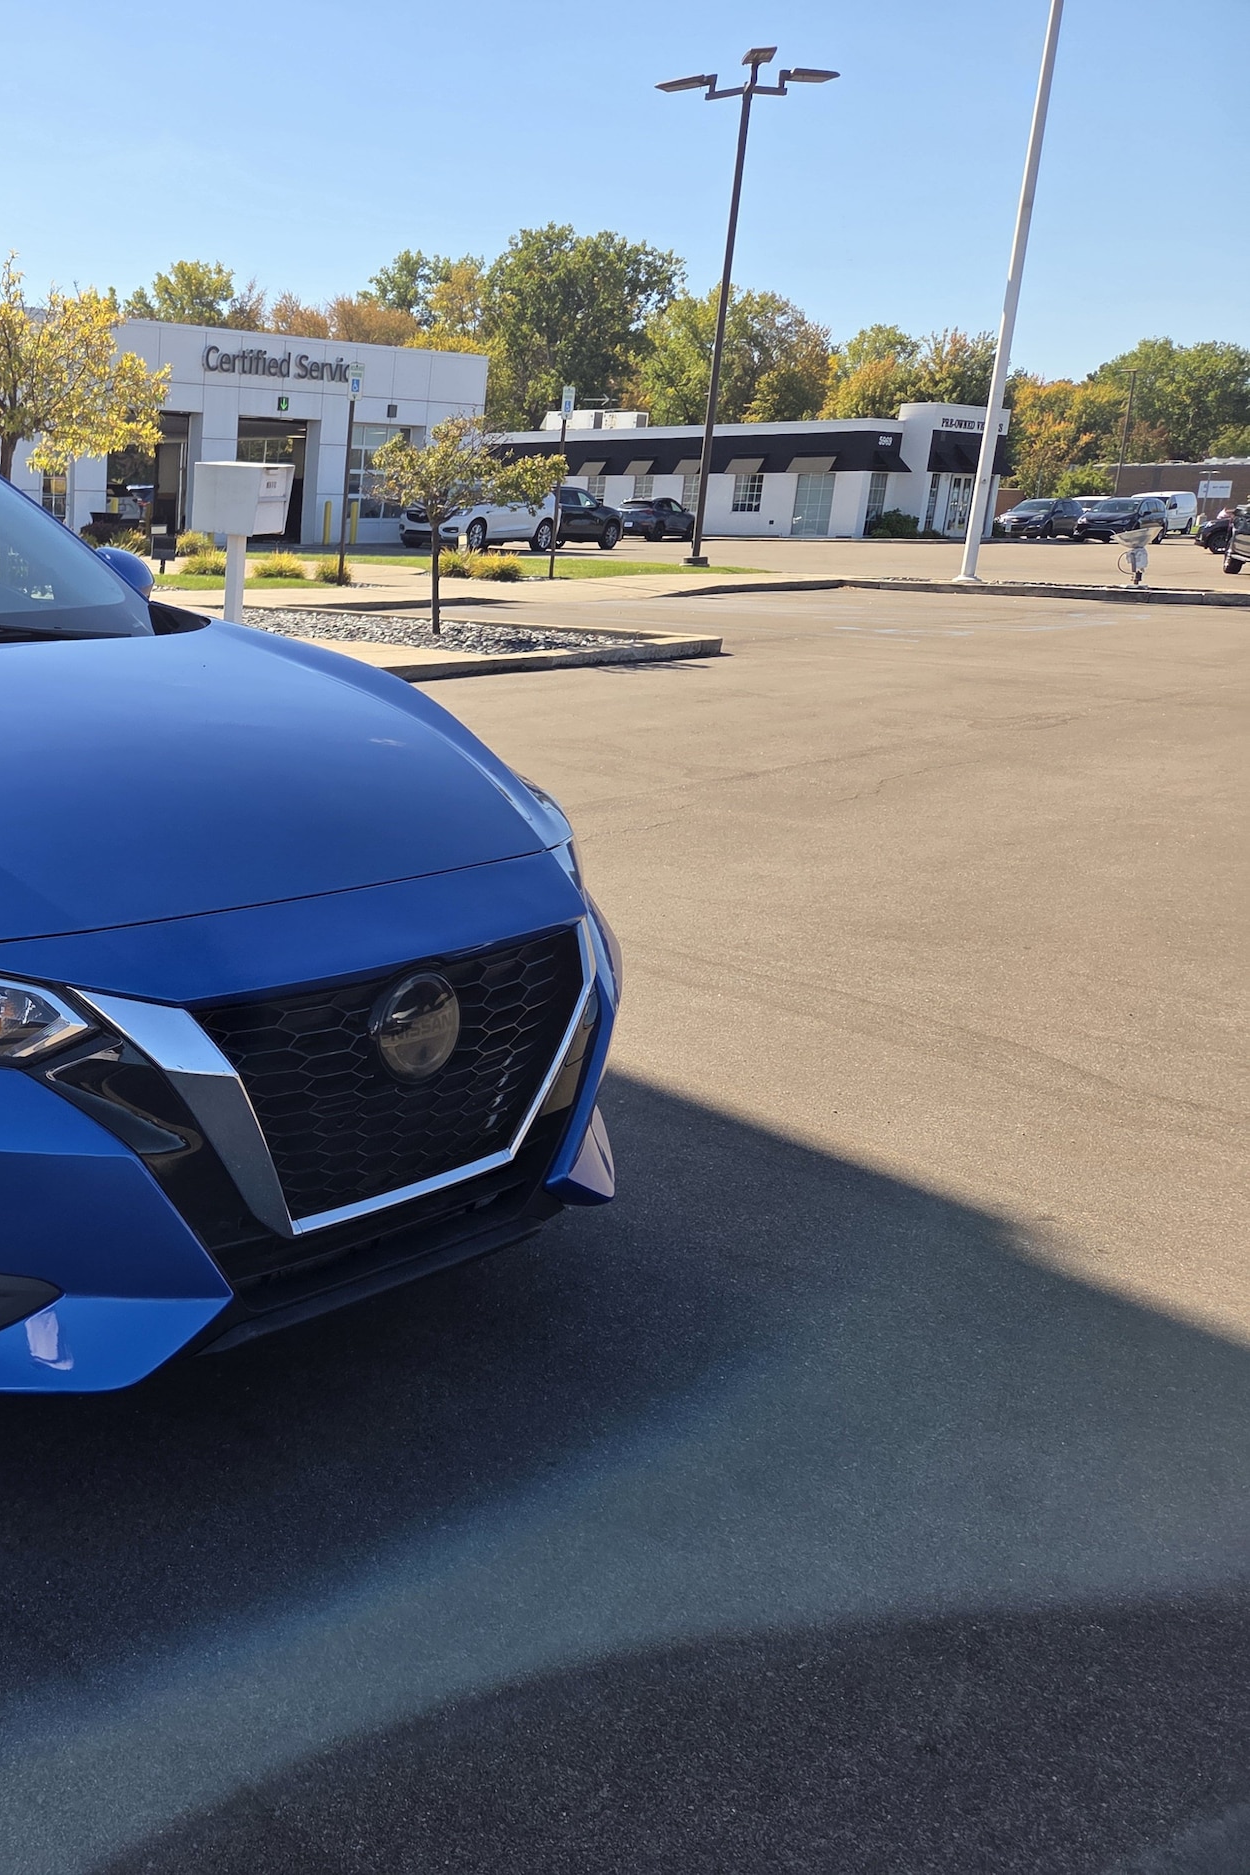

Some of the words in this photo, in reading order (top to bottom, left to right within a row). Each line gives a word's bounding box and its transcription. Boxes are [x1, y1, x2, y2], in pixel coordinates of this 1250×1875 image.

[203, 345, 291, 378] Certified
[295, 354, 350, 383] Servic
[941, 418, 976, 430] PRE-OWNED
[391, 1009, 452, 1042] NISSAN
